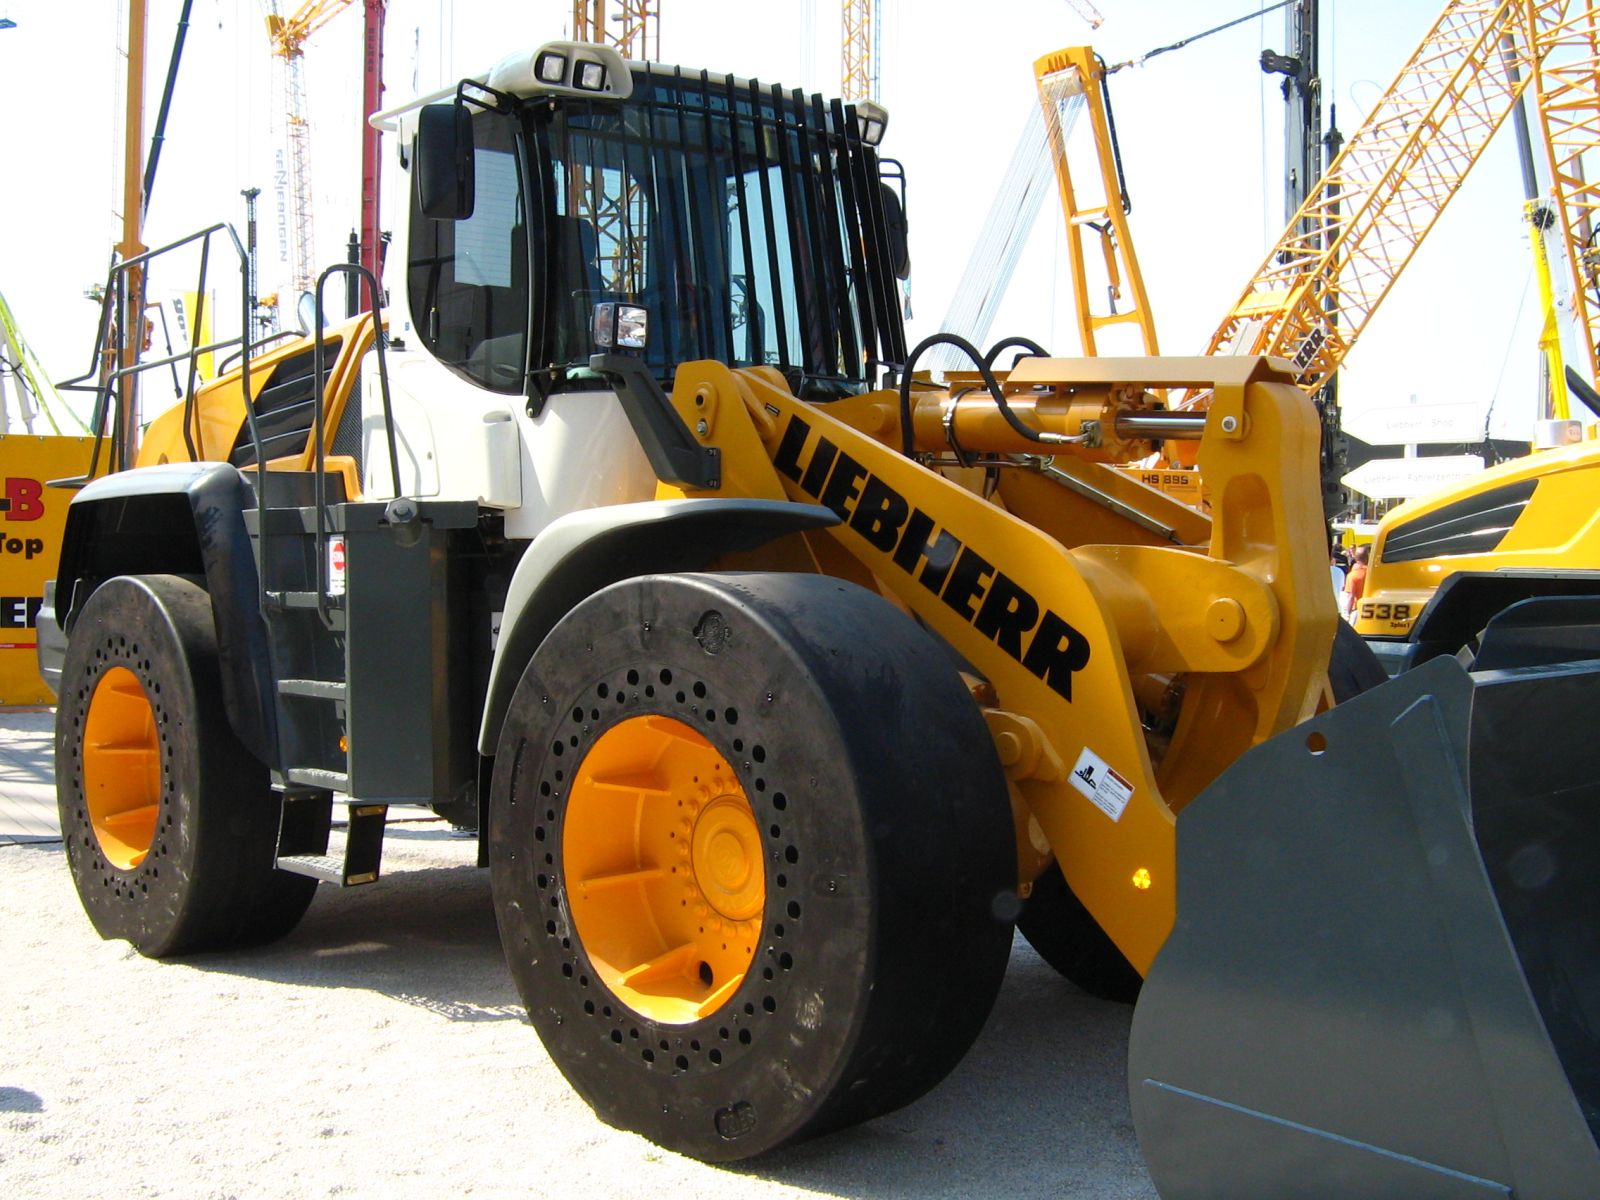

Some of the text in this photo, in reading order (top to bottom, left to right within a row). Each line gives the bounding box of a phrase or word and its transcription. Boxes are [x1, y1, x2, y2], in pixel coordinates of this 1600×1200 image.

[1142, 474, 1159, 484] HS
[773, 414, 1090, 703] LIEBHERR
[1361, 604, 1410, 619] 538
